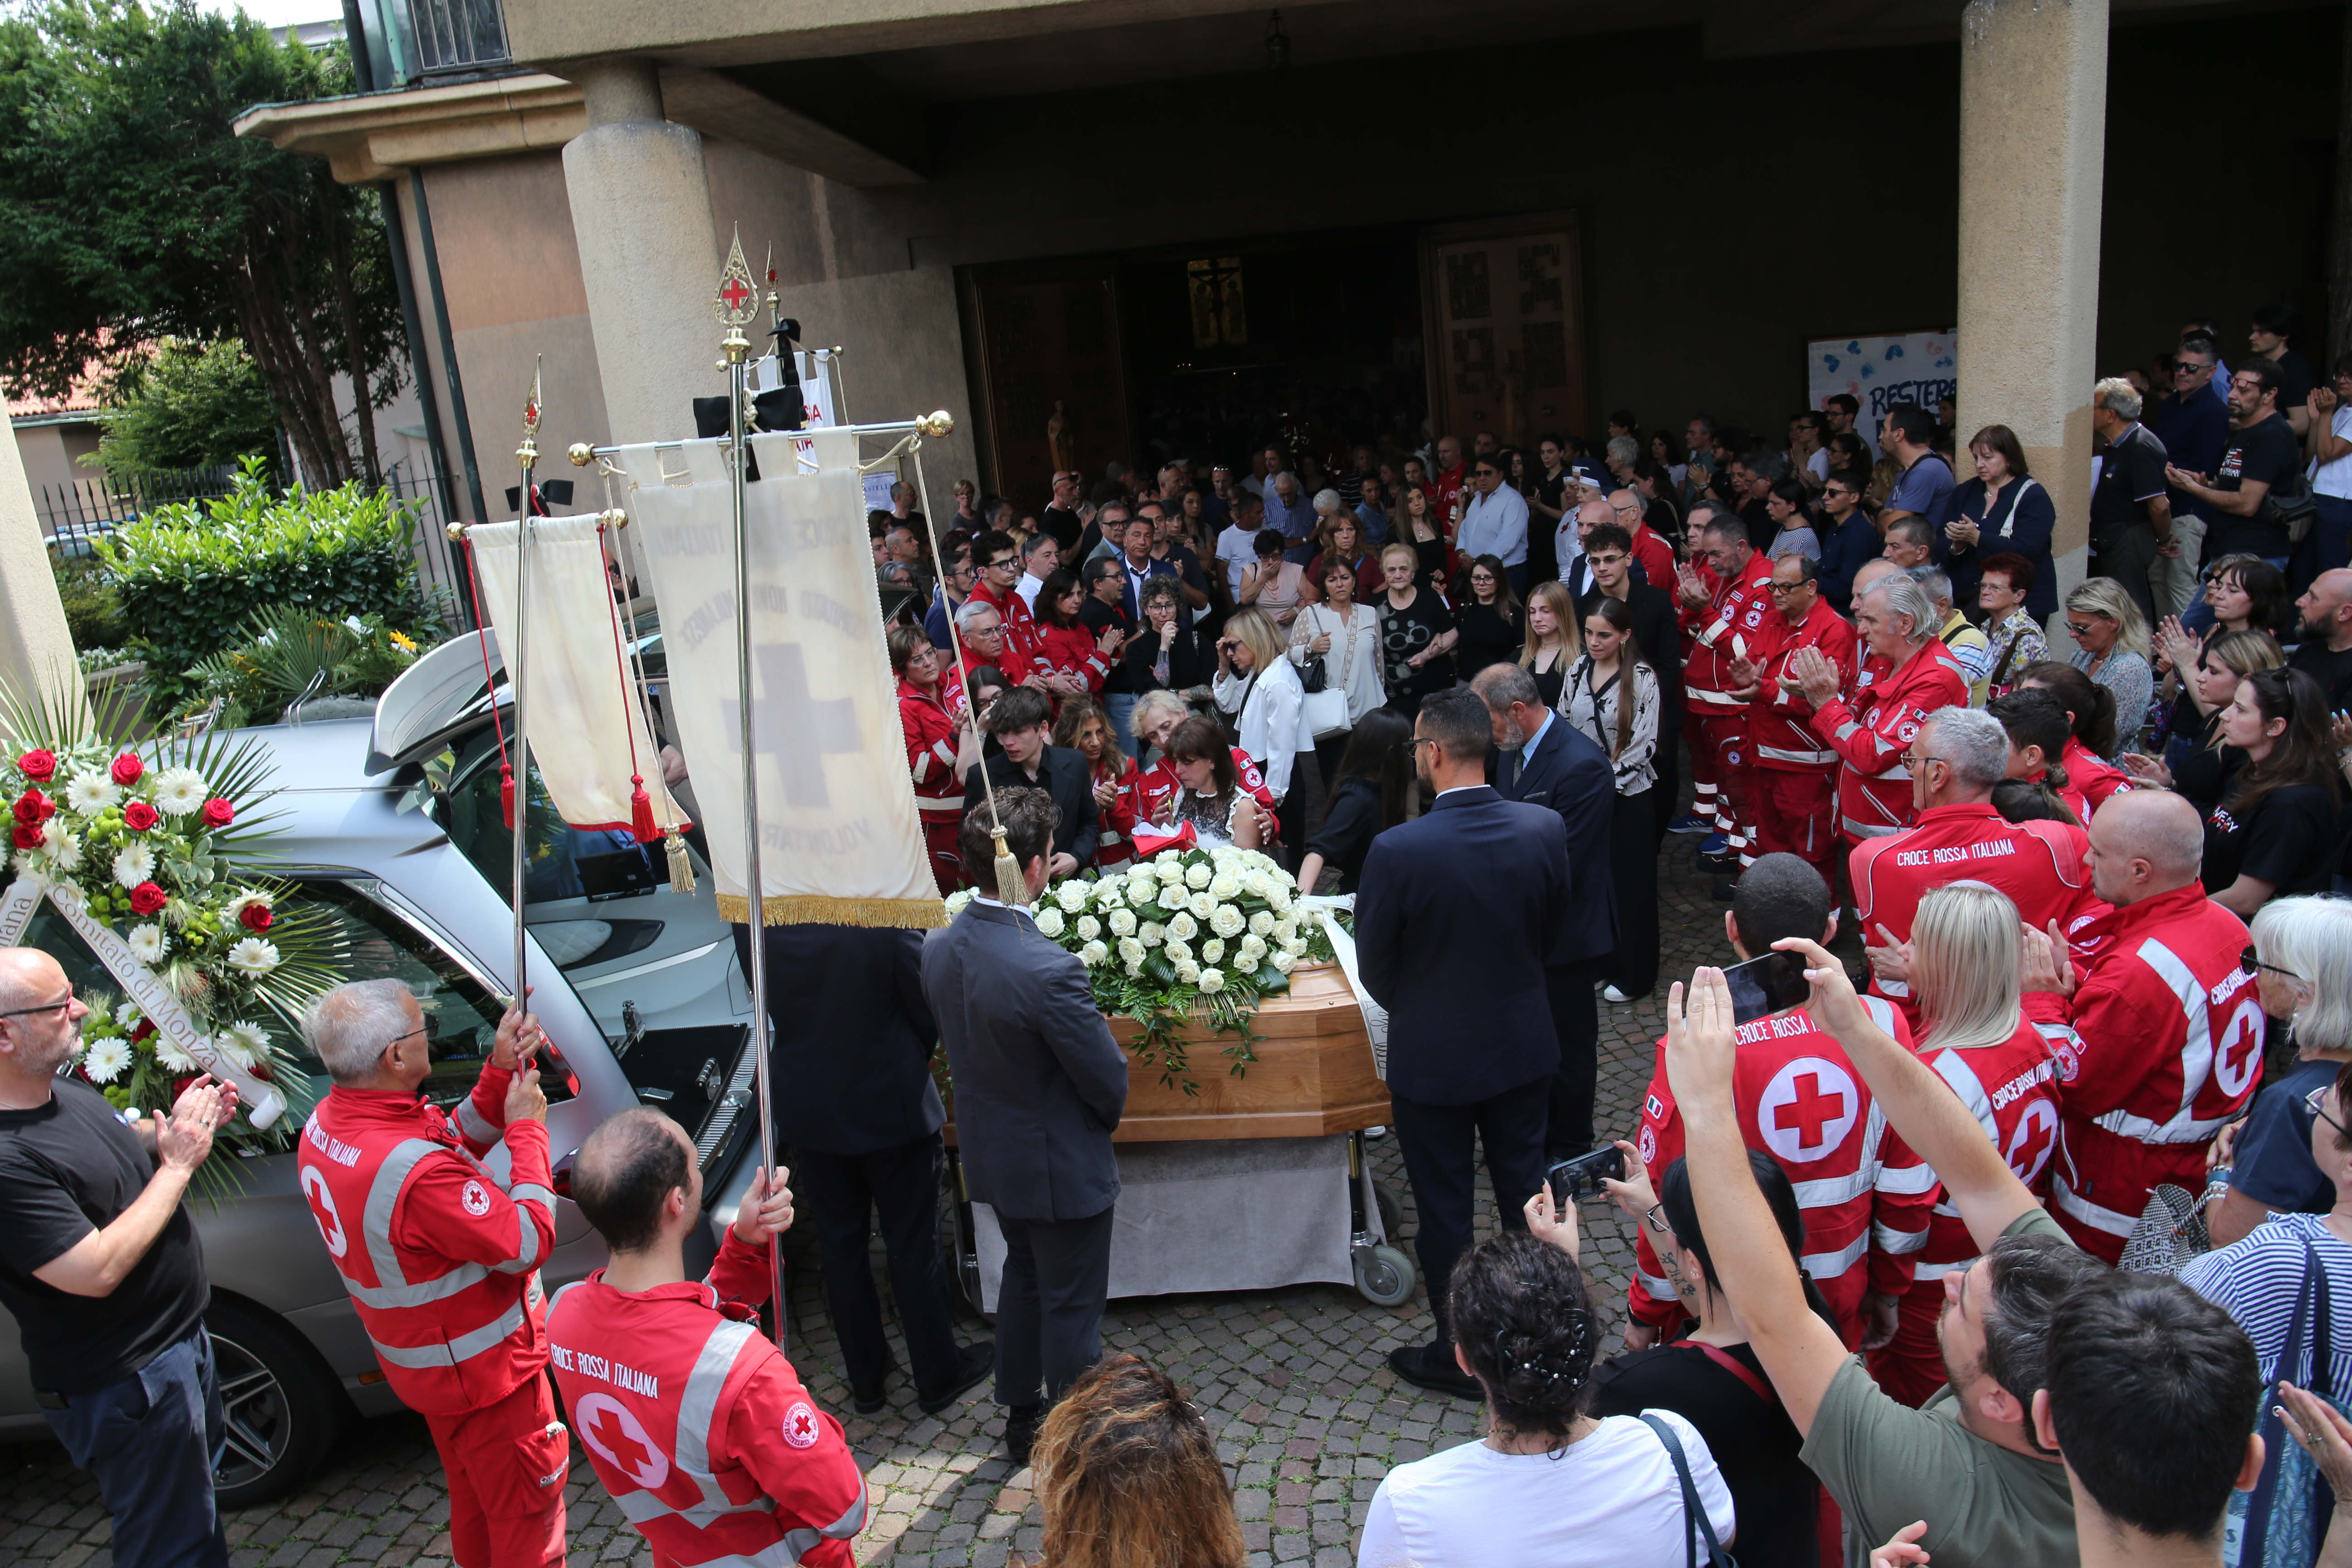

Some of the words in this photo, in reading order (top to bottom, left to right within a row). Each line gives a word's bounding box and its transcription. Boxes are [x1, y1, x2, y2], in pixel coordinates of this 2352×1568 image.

[1897, 850, 1930, 867] CROCE
[1933, 847, 1968, 864] ROSSA
[1971, 838, 2015, 859] ITALIANA
[53, 886, 136, 978] Comitato
[133, 978, 159, 1002] di
[149, 995, 217, 1069] Monza
[1735, 1022, 1771, 1046] CROCE
[1769, 1014, 1810, 1039] ROSSA
[1992, 1080, 2020, 1111] CROCE
[310, 1124, 330, 1154] ROSSA
[327, 1137, 362, 1168] ITALIANA
[550, 1343, 575, 1372] CROCE
[577, 1352, 610, 1383] ROSSA
[613, 1362, 658, 1399] ITALIANA
